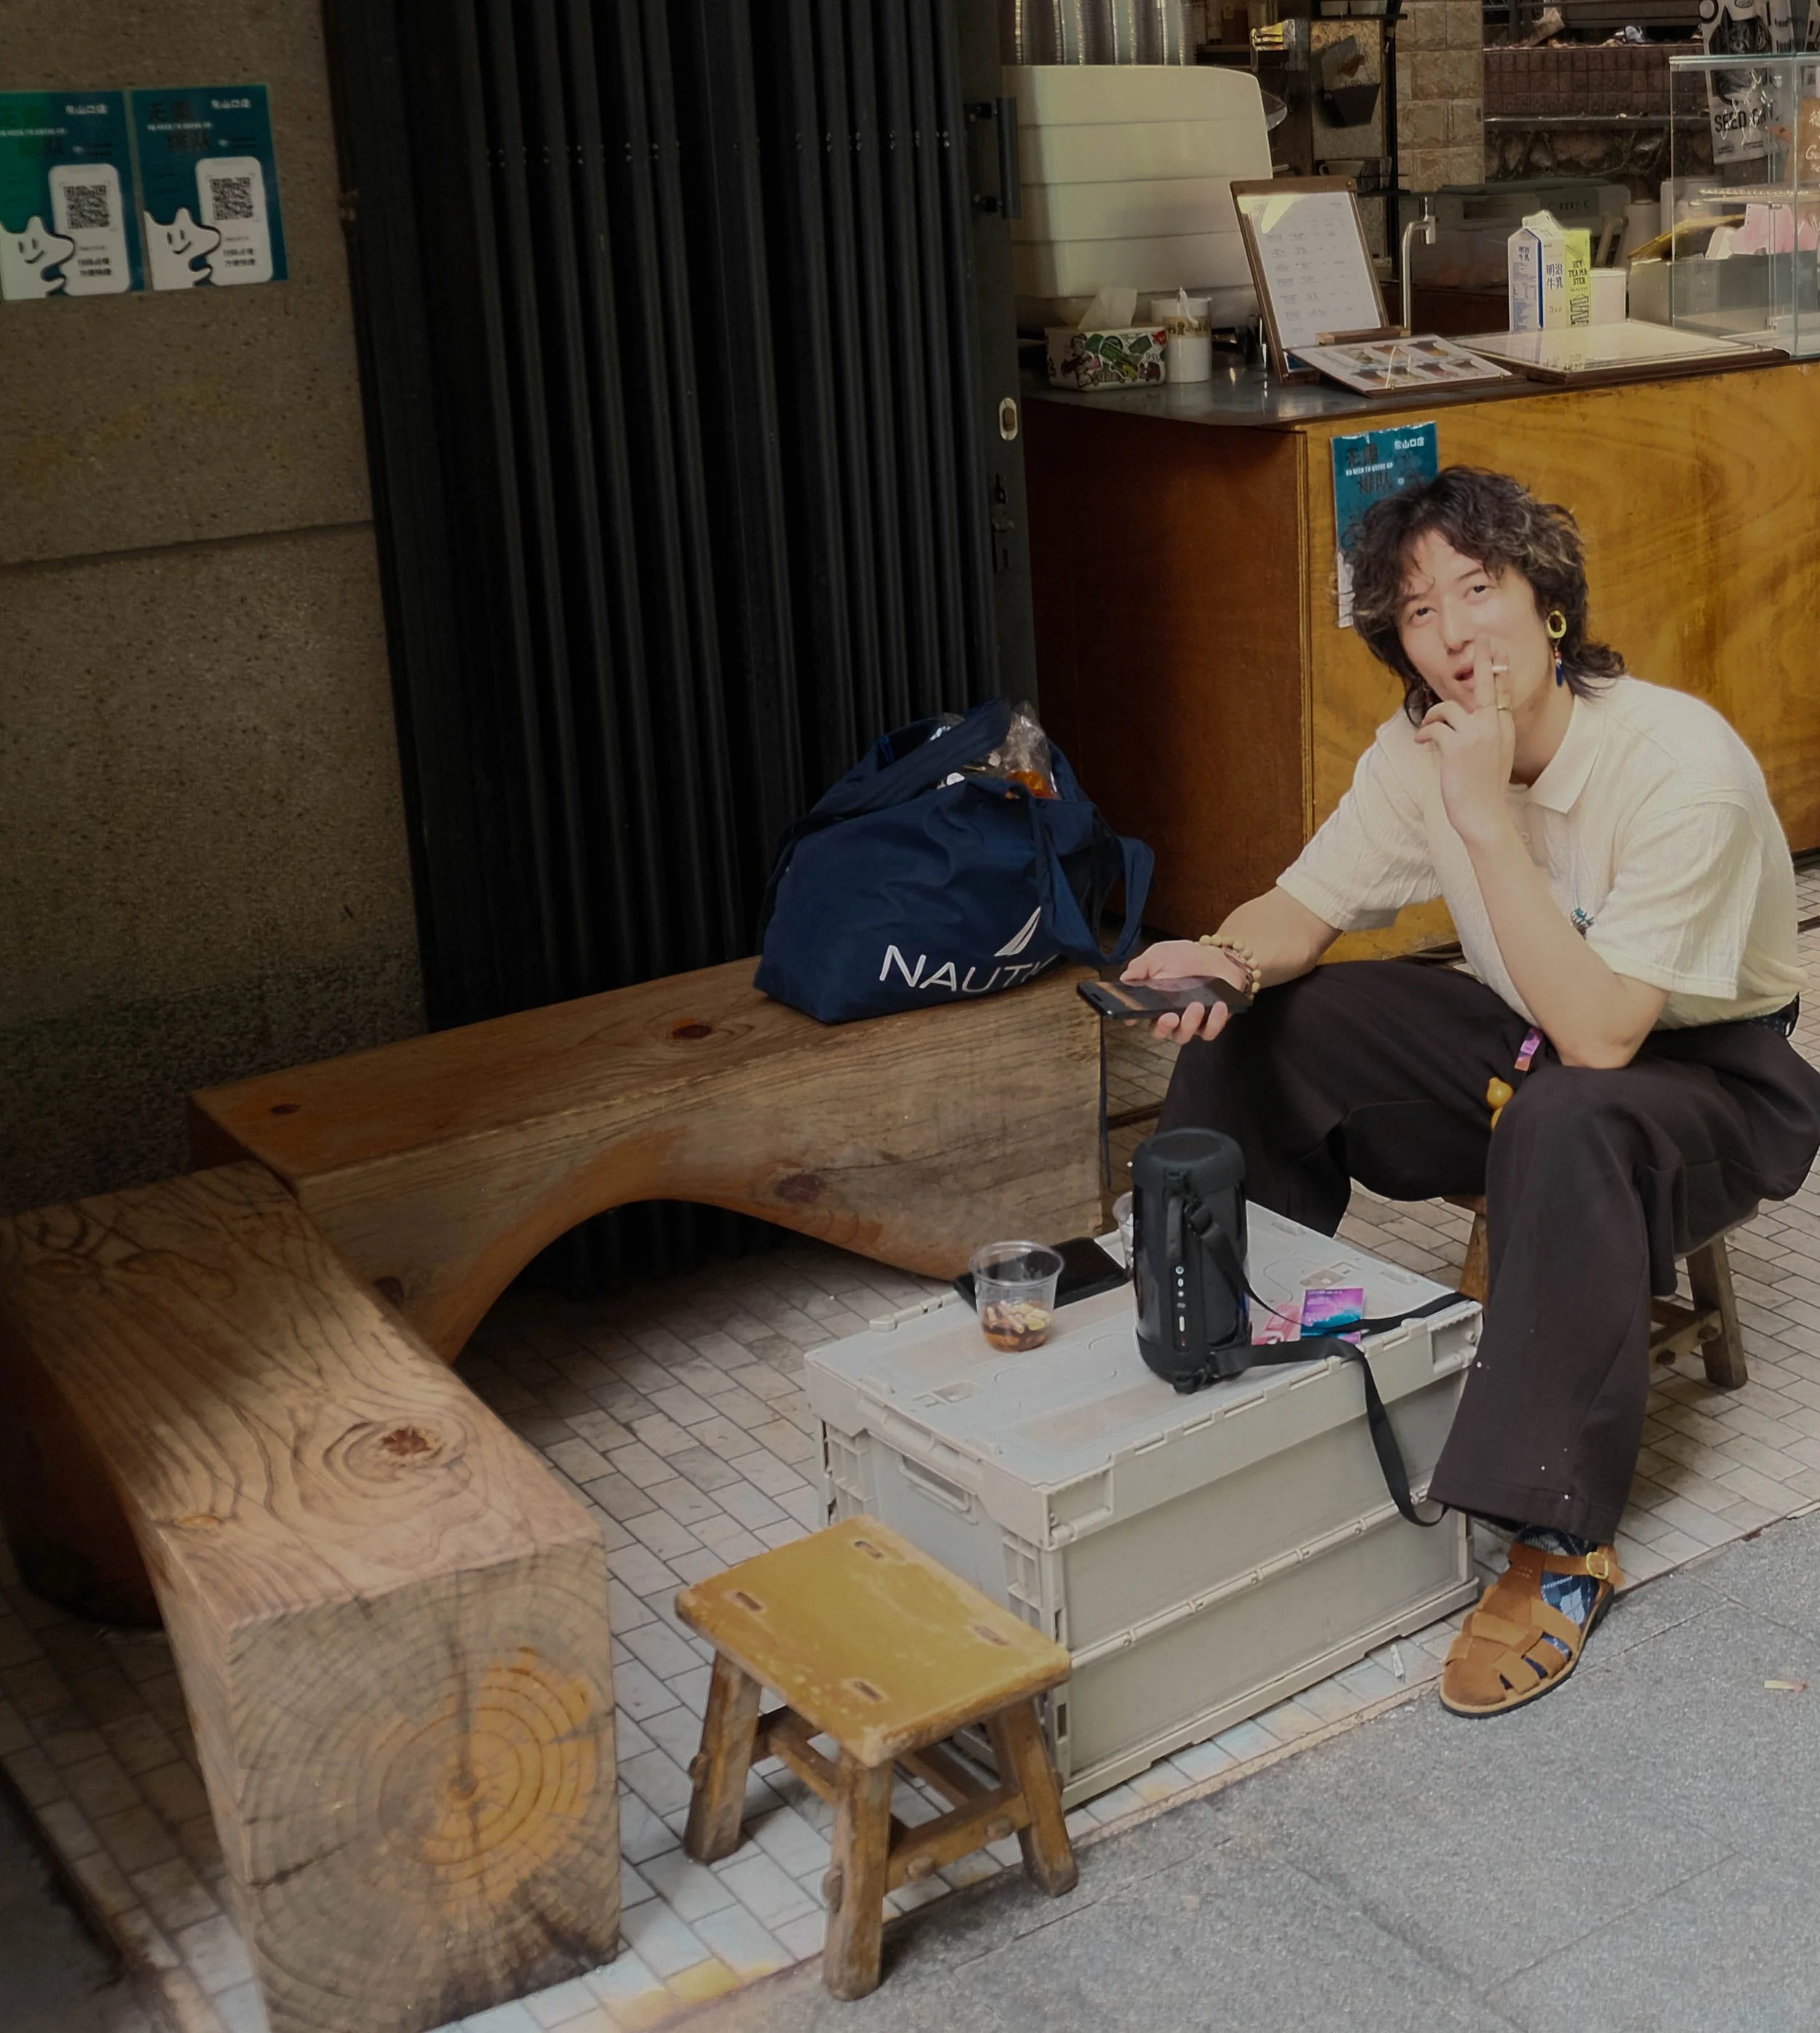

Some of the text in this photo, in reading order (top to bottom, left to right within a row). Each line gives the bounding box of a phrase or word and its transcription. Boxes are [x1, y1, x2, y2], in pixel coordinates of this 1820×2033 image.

[1714, 111, 1746, 132] SEED
[1546, 263, 1563, 276] 明治
[1547, 276, 1564, 290] 牛乳
